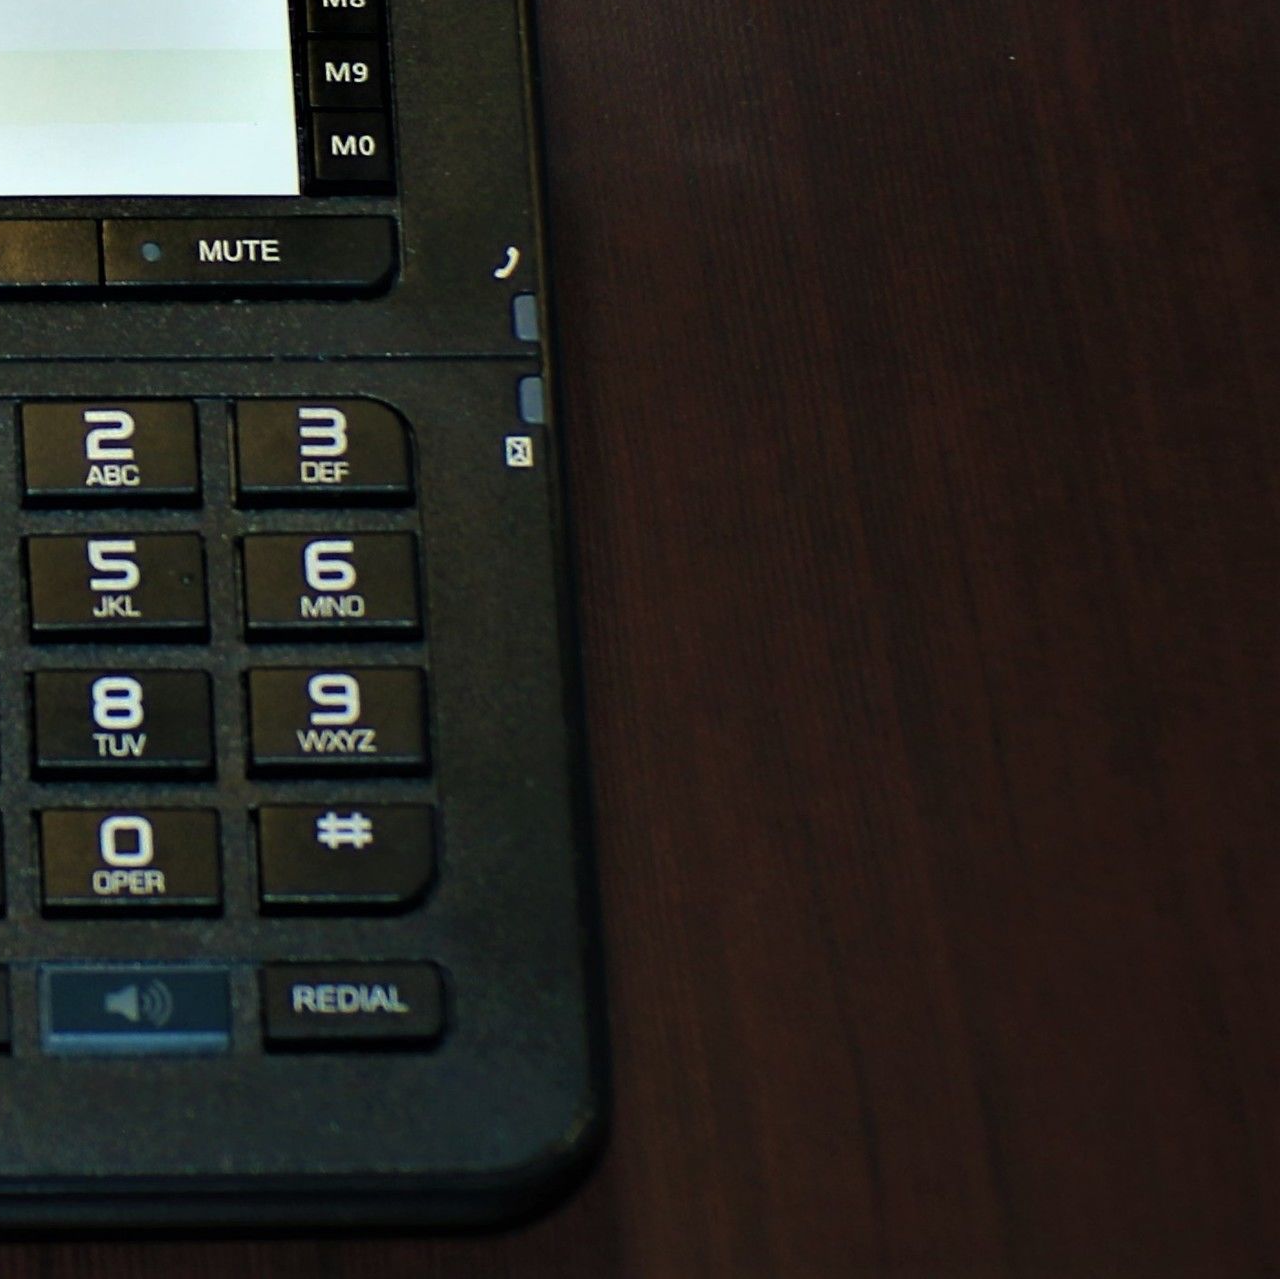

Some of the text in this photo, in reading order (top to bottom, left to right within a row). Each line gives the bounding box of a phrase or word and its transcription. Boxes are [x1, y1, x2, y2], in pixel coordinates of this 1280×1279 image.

[324, 61, 369, 83] M9
[331, 135, 376, 156] M0
[198, 239, 281, 262] MUTE
[84, 410, 135, 460] 2
[298, 407, 348, 457] 3
[85, 464, 140, 486] ABC
[300, 461, 349, 483] DEF
[87, 540, 140, 591] 5
[304, 540, 357, 591] 6
[92, 595, 142, 618] JKL
[300, 595, 365, 617] MNO
[92, 677, 143, 729] 8
[308, 674, 361, 725] 9
[92, 733, 147, 757] TUV
[297, 729, 375, 752] WXYZ
[93, 870, 165, 894] OPER
[292, 985, 407, 1013] REDIAL
